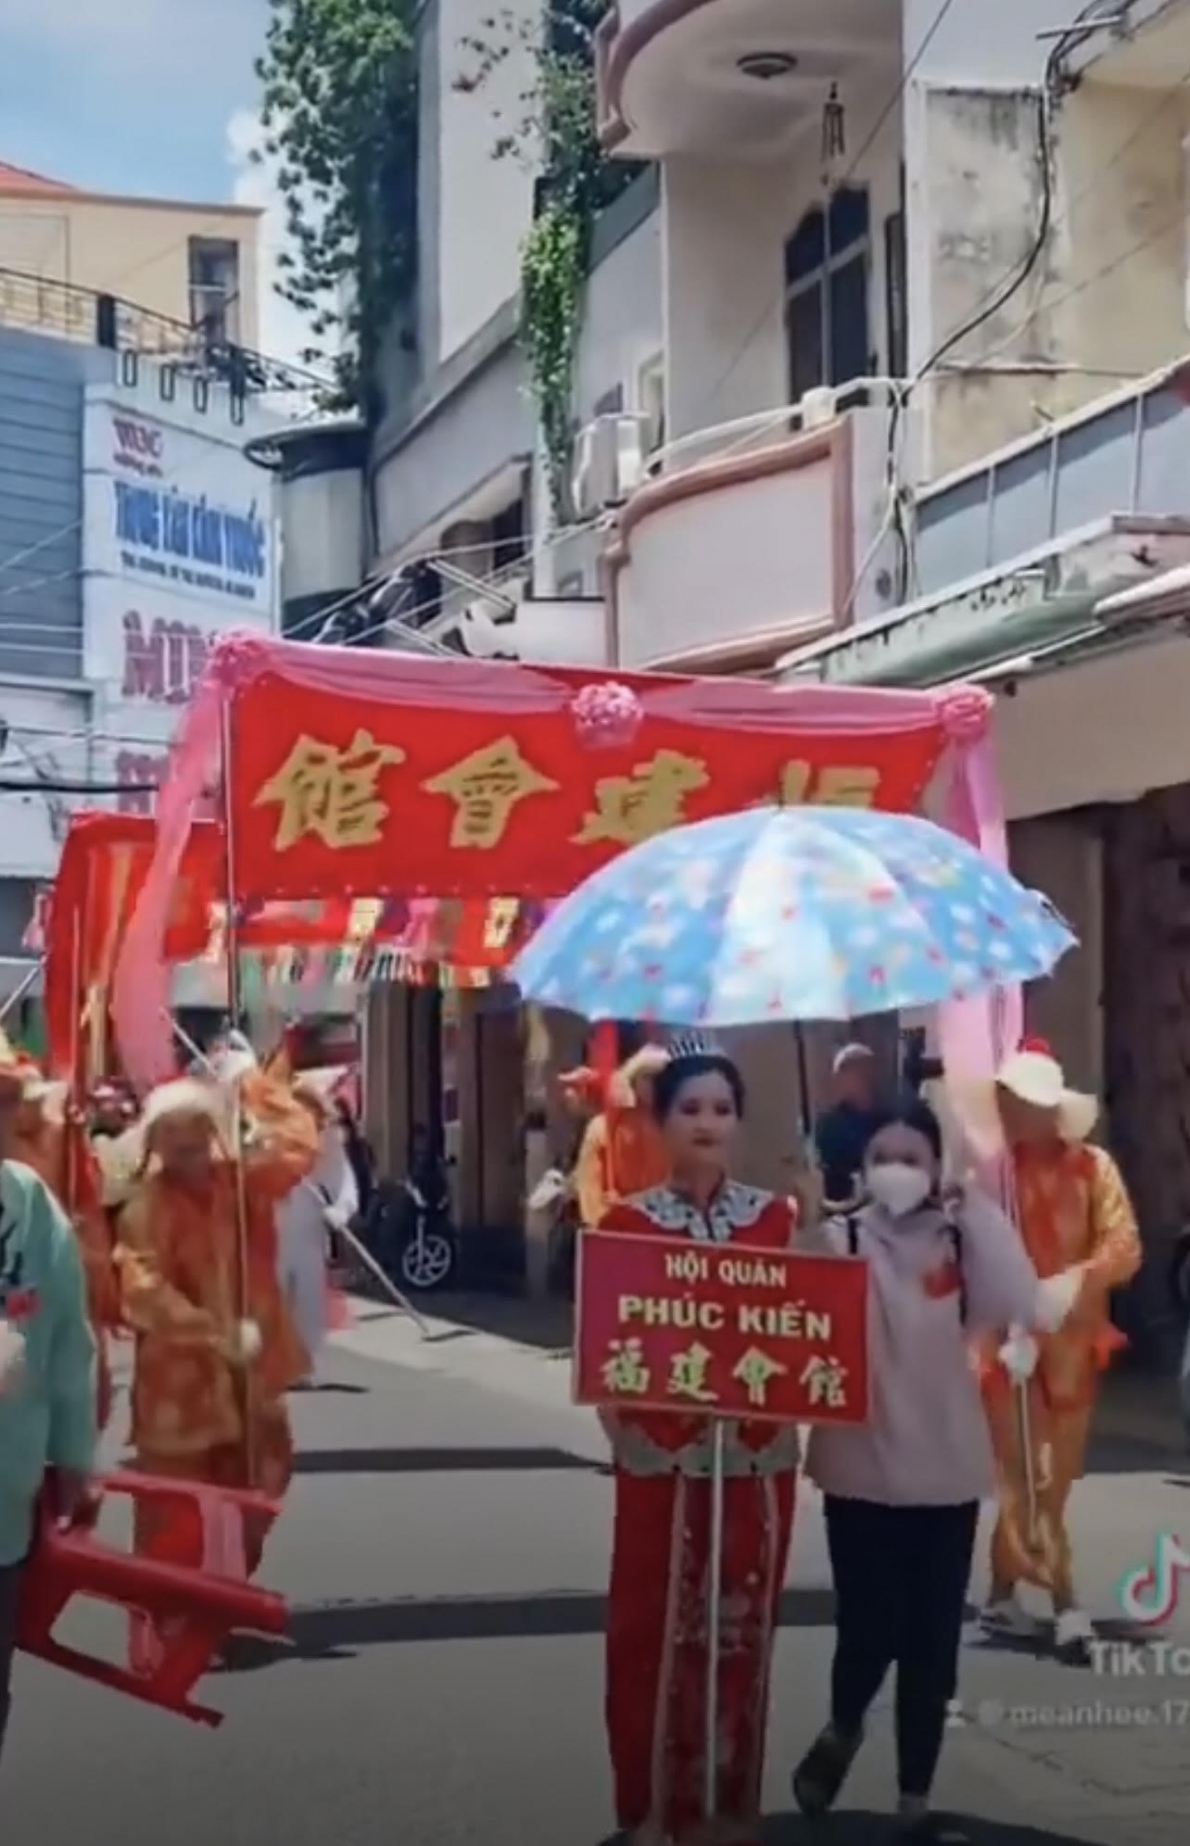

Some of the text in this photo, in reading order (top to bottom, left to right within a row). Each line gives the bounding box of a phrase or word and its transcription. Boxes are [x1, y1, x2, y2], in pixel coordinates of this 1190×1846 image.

[665, 1250, 708, 1285] HỘI
[618, 1293, 832, 1340] PHÚC KIẾN
